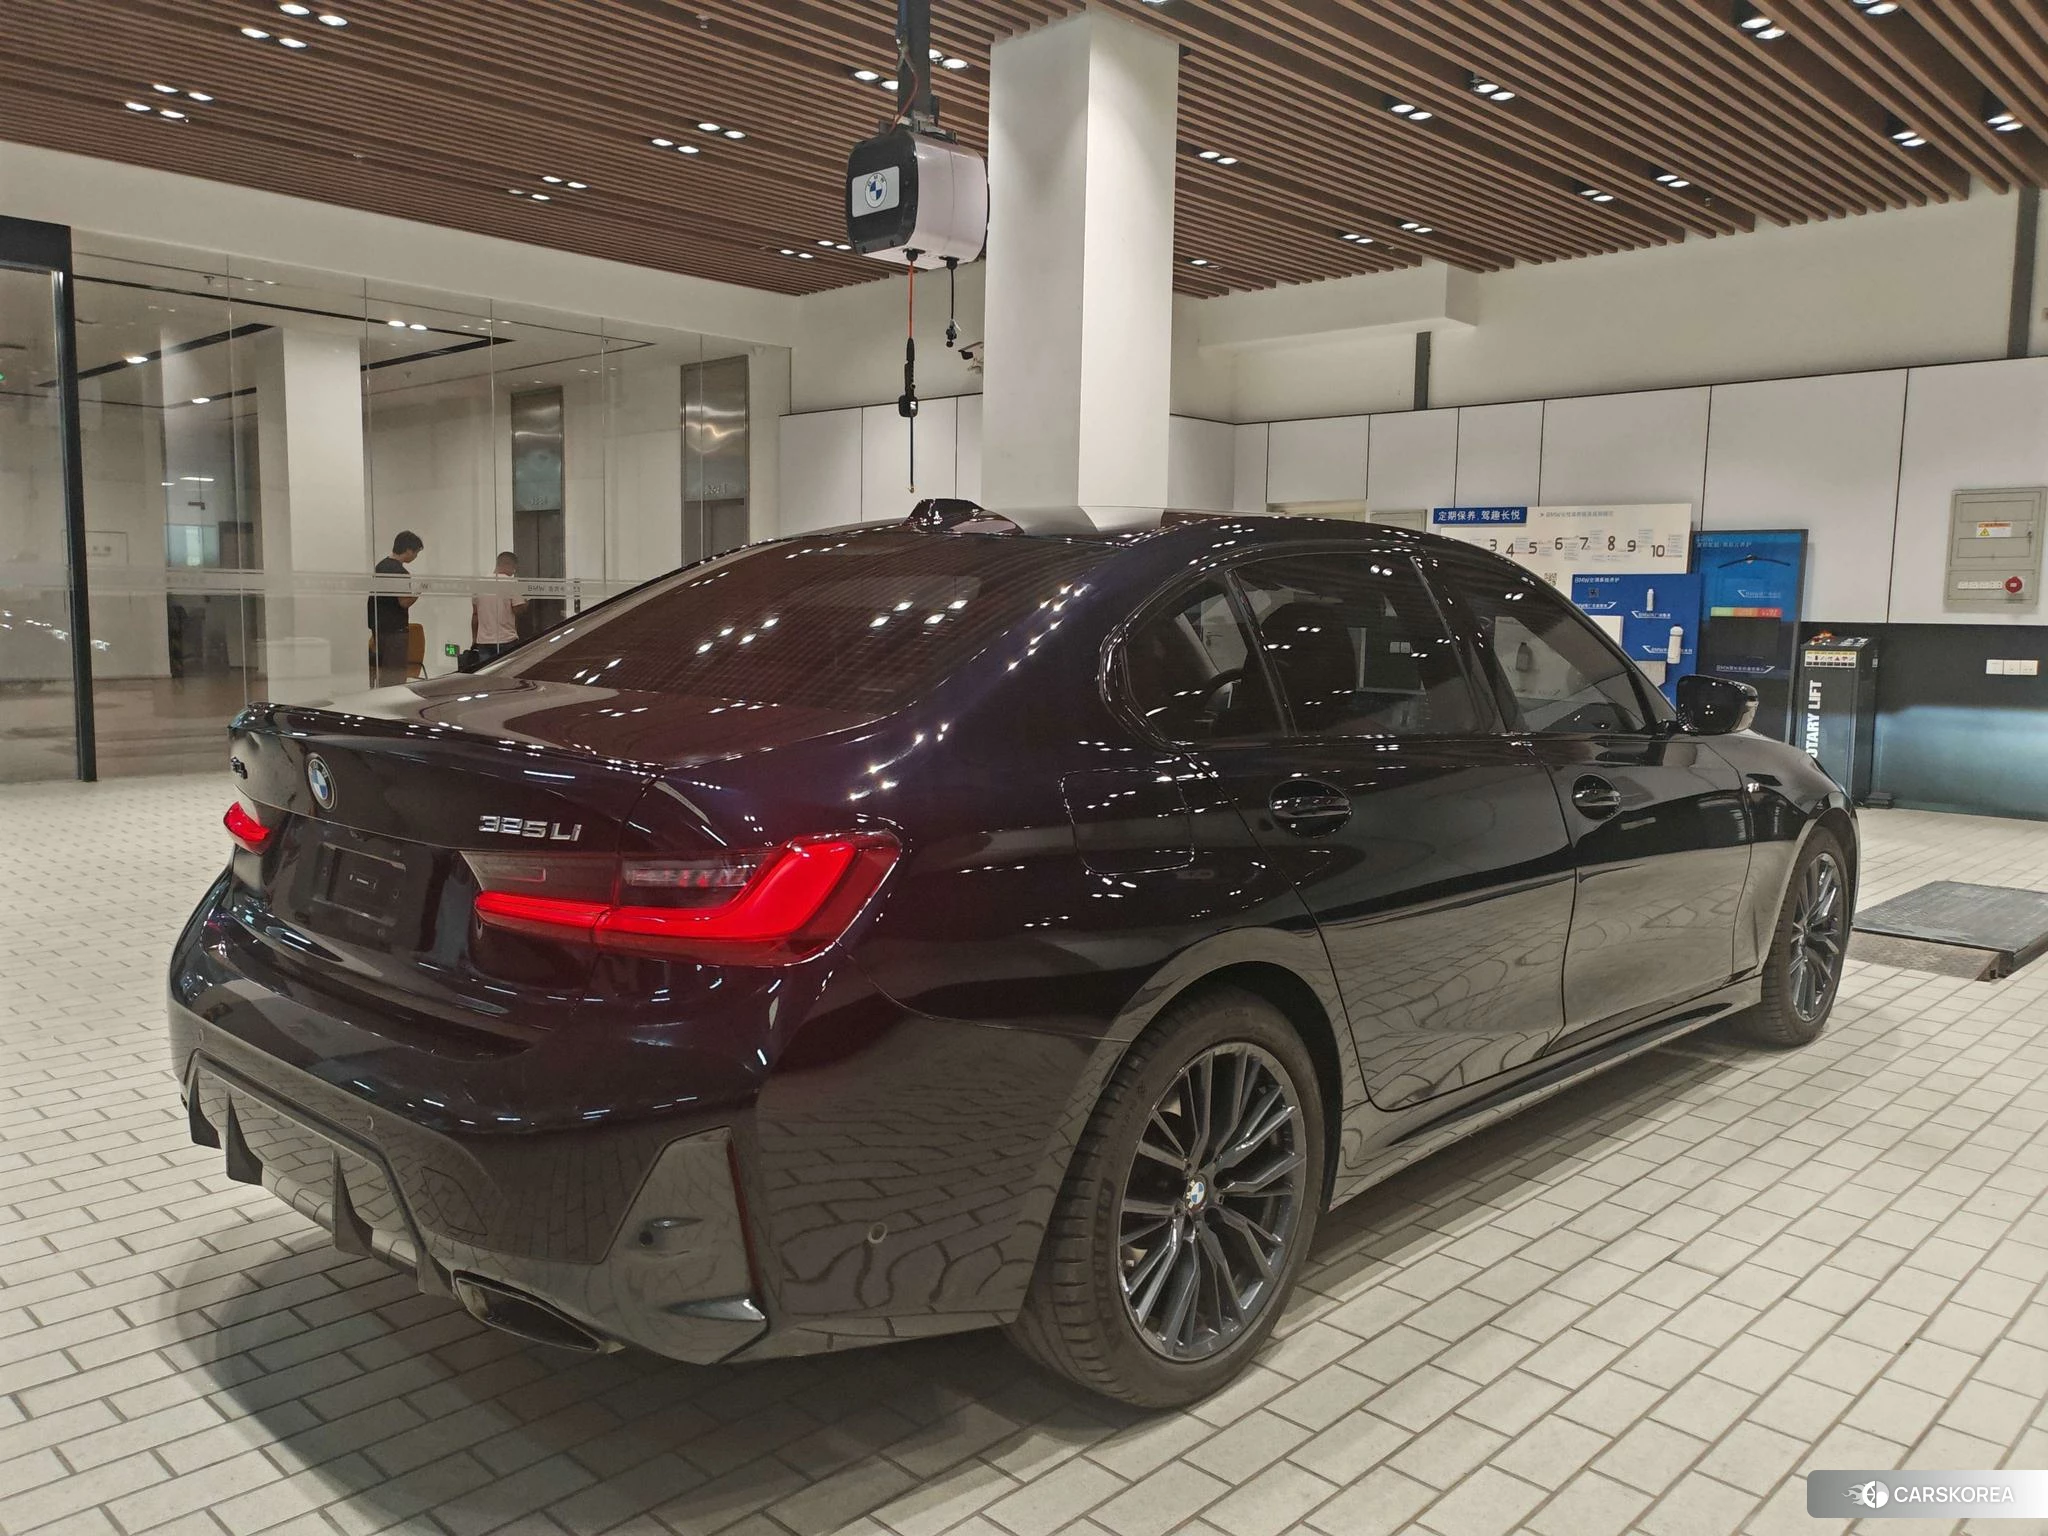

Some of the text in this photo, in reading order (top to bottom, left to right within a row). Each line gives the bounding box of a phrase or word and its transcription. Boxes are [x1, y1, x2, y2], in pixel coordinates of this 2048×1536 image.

[1489, 539, 1498, 552] 3
[1505, 543, 1515, 557] 4
[1528, 542, 1538, 554] 5
[1554, 537, 1564, 550] 6
[1579, 537, 1589, 550] 7
[1607, 536, 1616, 551] 8
[1627, 540, 1636, 552] 9
[1651, 545, 1665, 557] 10
[1806, 680, 1822, 759] OTARY LIFT
